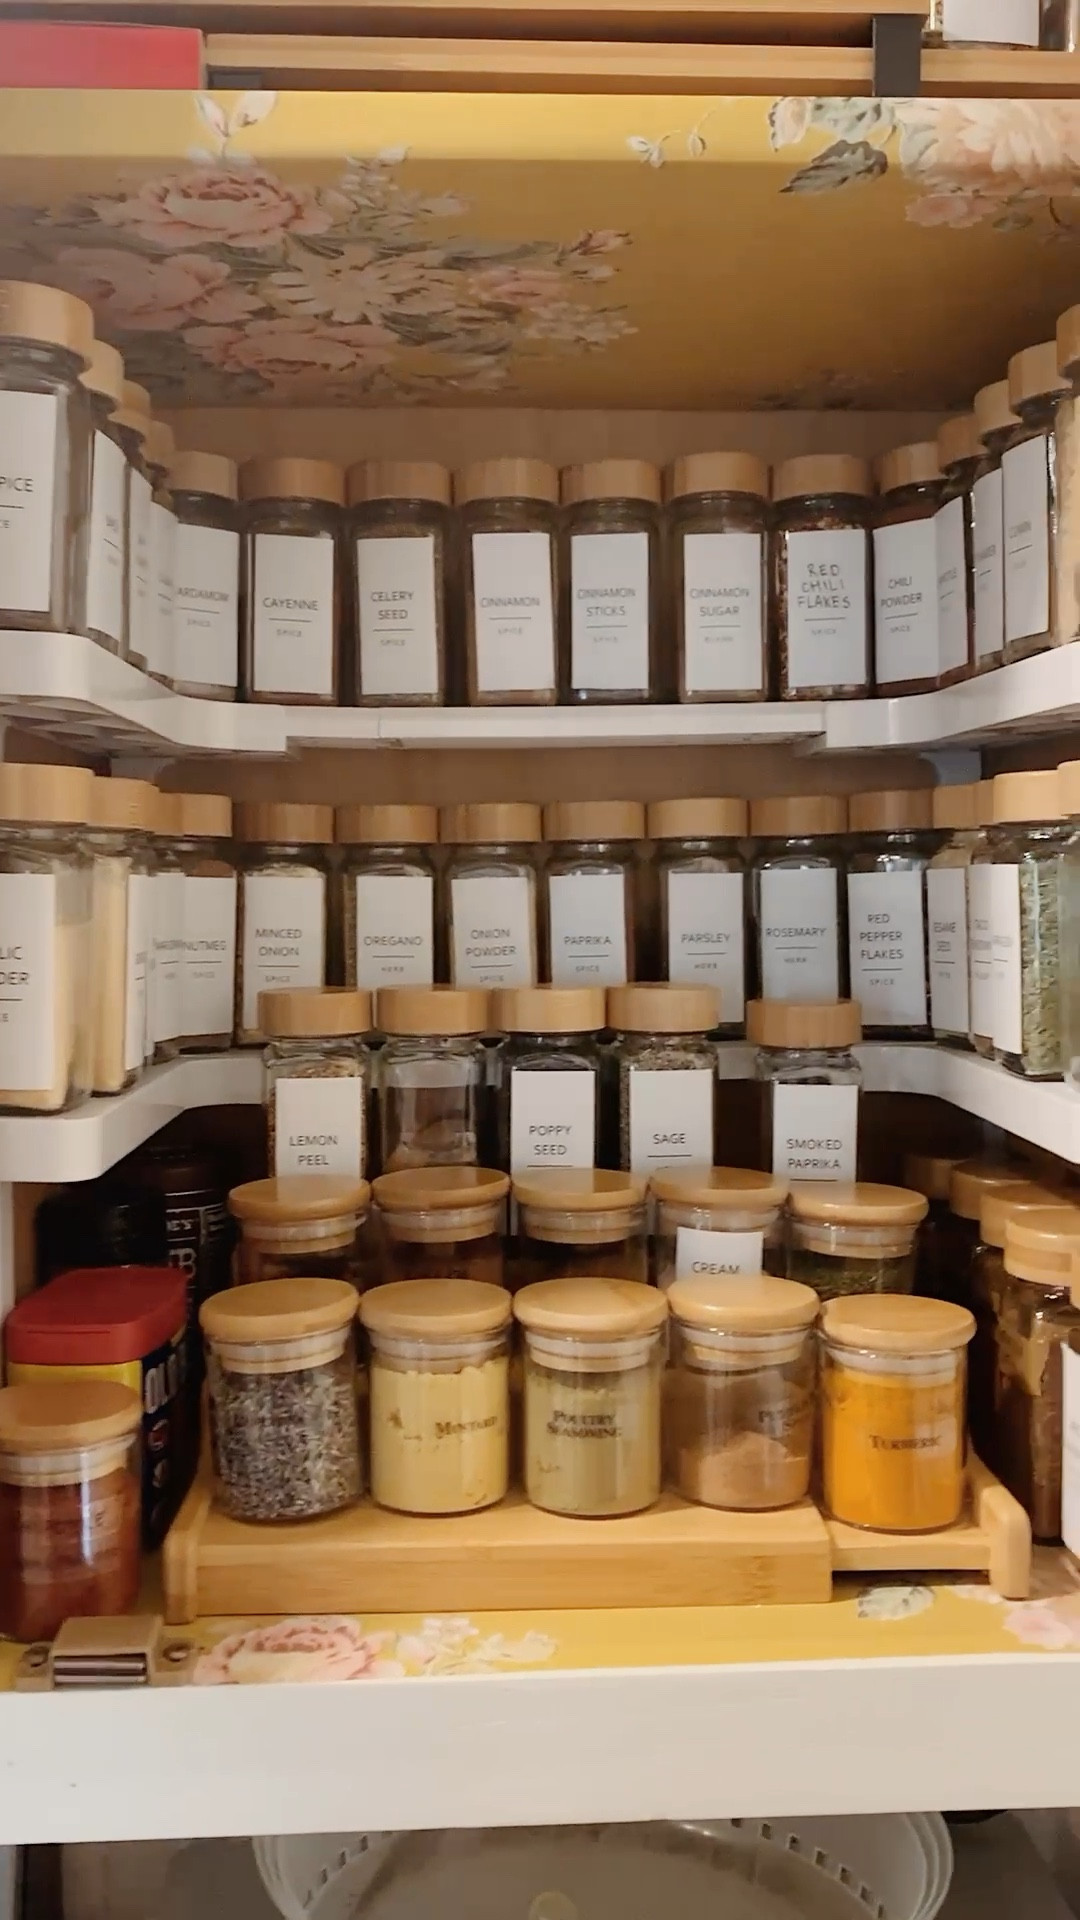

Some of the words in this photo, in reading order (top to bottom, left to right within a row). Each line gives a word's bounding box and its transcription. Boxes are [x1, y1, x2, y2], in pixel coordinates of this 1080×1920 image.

[806, 563, 841, 577] RED
[801, 579, 845, 593] CHILI
[887, 576, 913, 589] CHILI
[370, 591, 415, 602] CELERY
[577, 587, 637, 600] CINNAMON
[689, 586, 750, 599] CINNAMON
[263, 597, 319, 612] CAYENNE
[479, 596, 541, 608] CINNAMON
[797, 595, 852, 609] FLAKES
[880, 592, 923, 608] POWDER
[378, 608, 408, 620] SEED
[586, 605, 626, 618] STICKS
[699, 606, 740, 617] SUGAR
[867, 912, 891, 925] RED
[255, 927, 303, 940] MINCED
[470, 928, 511, 941] ONION
[680, 932, 732, 945] PARSLEY
[765, 926, 827, 939] ROSEMARY
[859, 930, 903, 943] PEPPER
[363, 935, 423, 947] OREGANO
[563, 935, 613, 947] PAPRIKA
[258, 946, 300, 957] ONION
[465, 945, 517, 958] POWDER
[860, 949, 904, 961] FLAKES
[528, 1124, 573, 1137] POPPY
[289, 1135, 339, 1147] LEMON
[652, 1132, 686, 1145] SAGE
[786, 1138, 843, 1151] SMOKED
[533, 1144, 568, 1156] SEED
[298, 1154, 329, 1166] PEEL
[787, 1157, 841, 1170] PAPRIKA
[691, 1260, 741, 1275] CREAM
